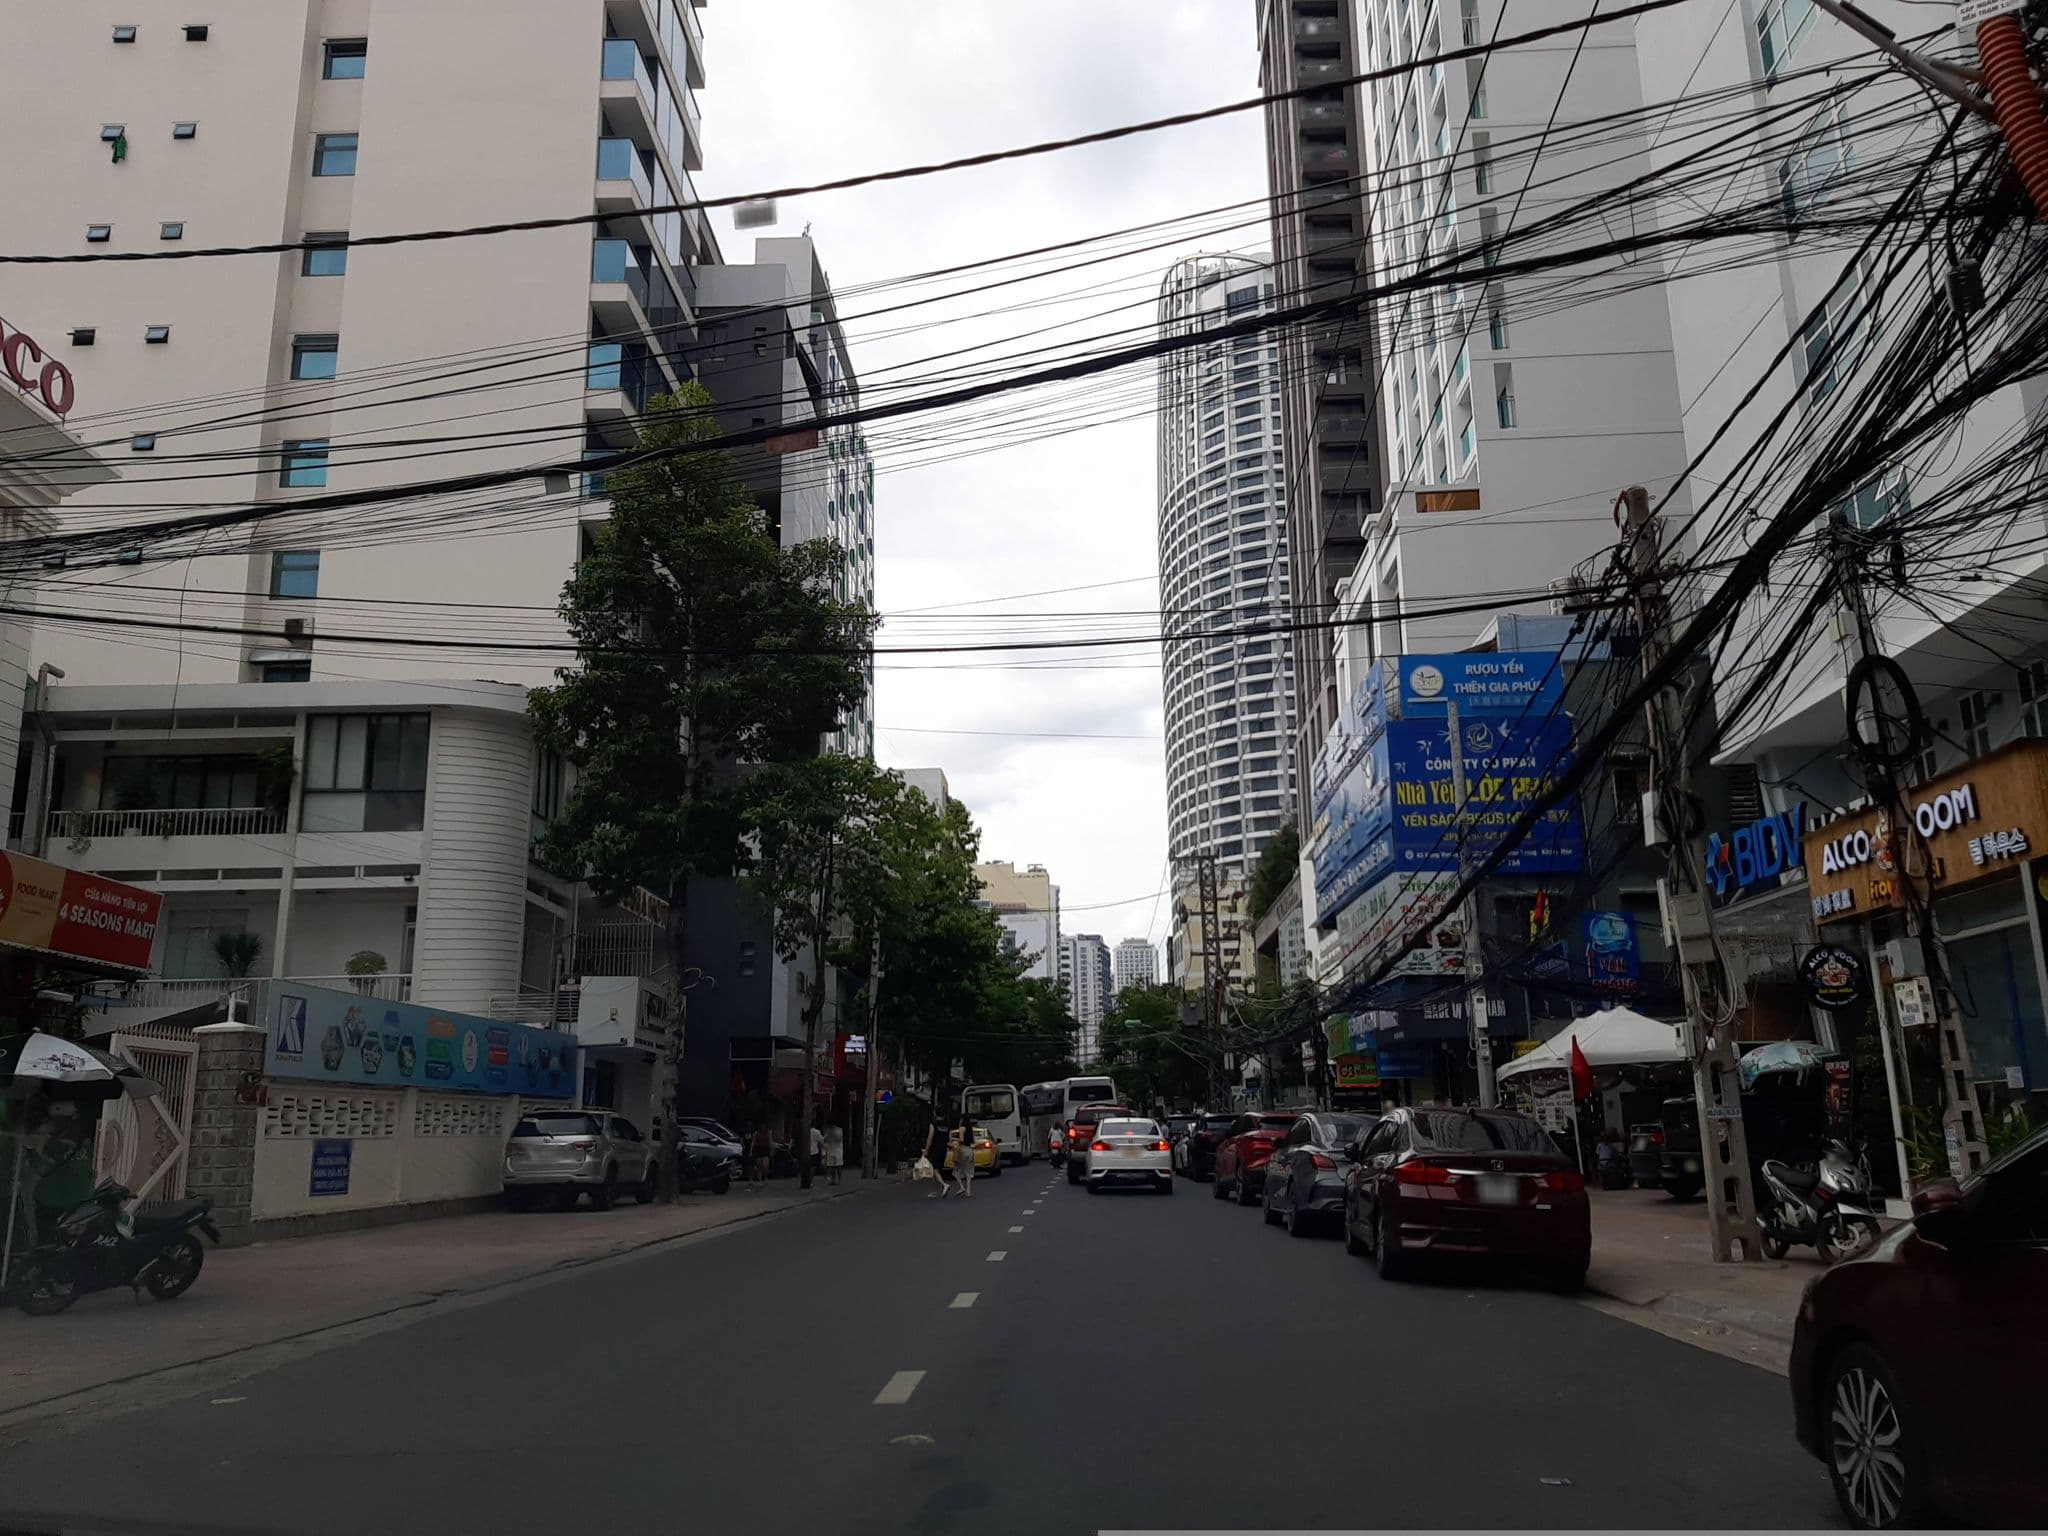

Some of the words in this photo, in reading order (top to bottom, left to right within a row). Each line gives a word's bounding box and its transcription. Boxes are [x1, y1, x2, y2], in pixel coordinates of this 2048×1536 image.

[0, 320, 74, 413] CO
[1502, 658, 1524, 674] YẾN
[1488, 681, 1510, 693] GIA
[1425, 757, 1454, 770] CÔN
[1463, 758, 1479, 770] TY
[1396, 778, 1427, 805] Nhà
[1822, 830, 1870, 875] ALCO
[1916, 783, 1977, 838] OOM
[1733, 802, 1807, 887] BIDV
[59, 903, 68, 920] 4
[70, 905, 125, 932] SEASONS
[124, 919, 156, 941] MART
[1808, 950, 1829, 969] ALCO
[1834, 951, 1859, 969] OOM
